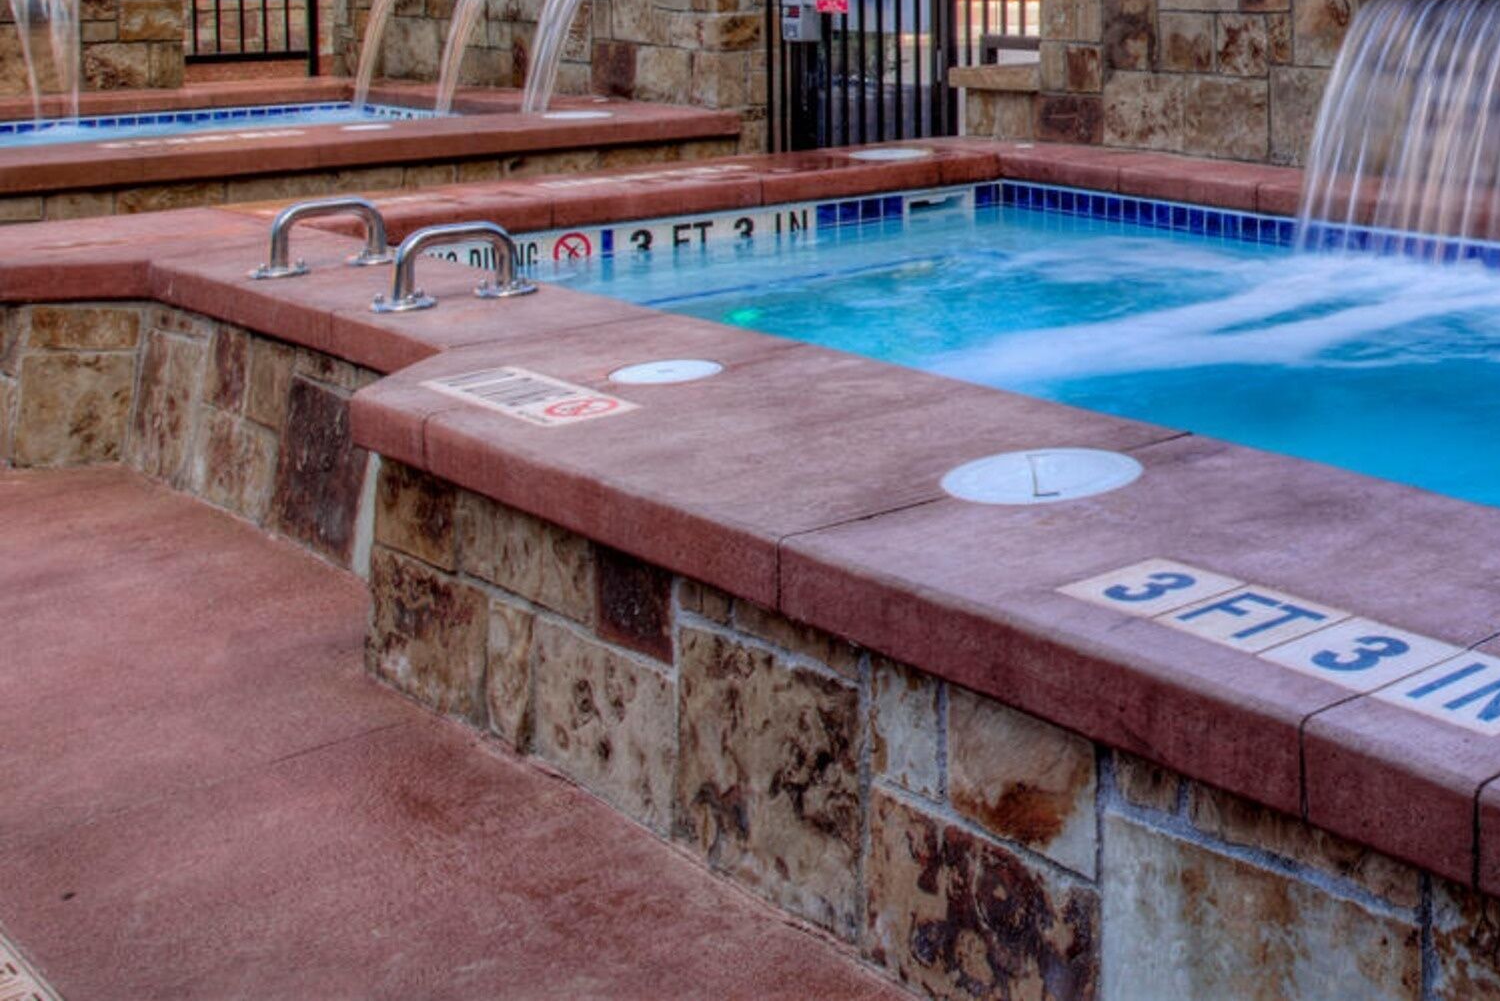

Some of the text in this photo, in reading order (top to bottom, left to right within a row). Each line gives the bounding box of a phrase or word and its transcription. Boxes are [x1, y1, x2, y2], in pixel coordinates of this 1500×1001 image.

[629, 208, 808, 252] 3 FT 3 IN
[469, 241, 539, 271] DING
[1103, 572, 1197, 603] 3
[1175, 591, 1328, 639] FT
[1310, 635, 1411, 672] 3
